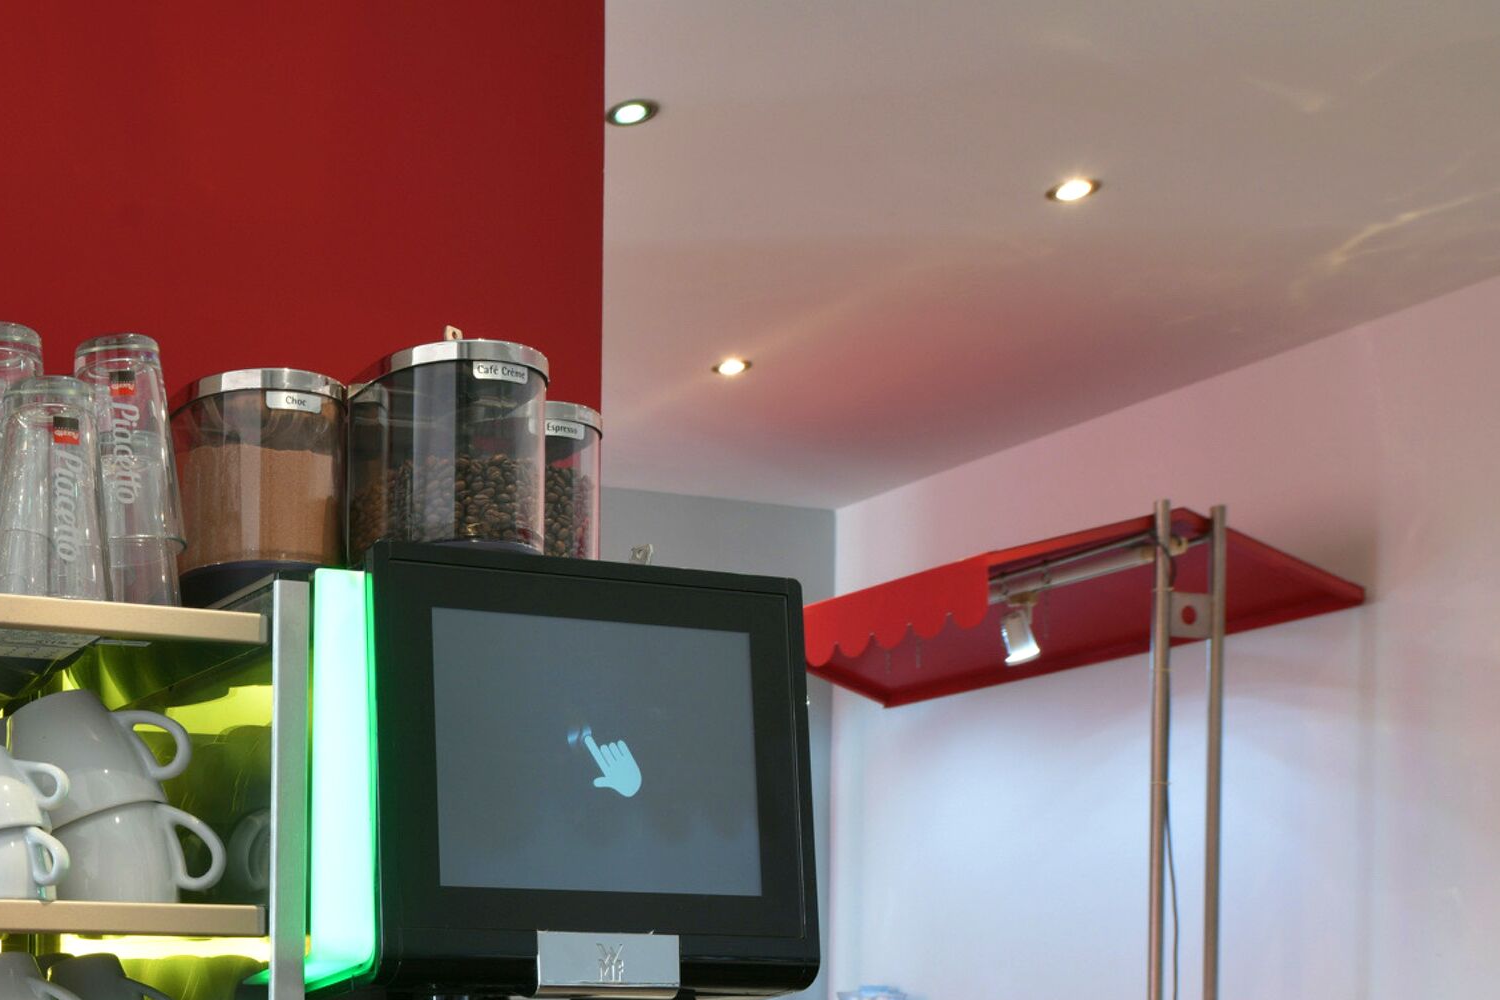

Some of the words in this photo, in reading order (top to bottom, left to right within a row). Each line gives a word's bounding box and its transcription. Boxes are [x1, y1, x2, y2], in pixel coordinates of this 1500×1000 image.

[285, 395, 307, 407] Choc
[546, 423, 578, 435] Espresso
[111, 401, 142, 504] Piacetto
[55, 450, 87, 562] Piacetto
